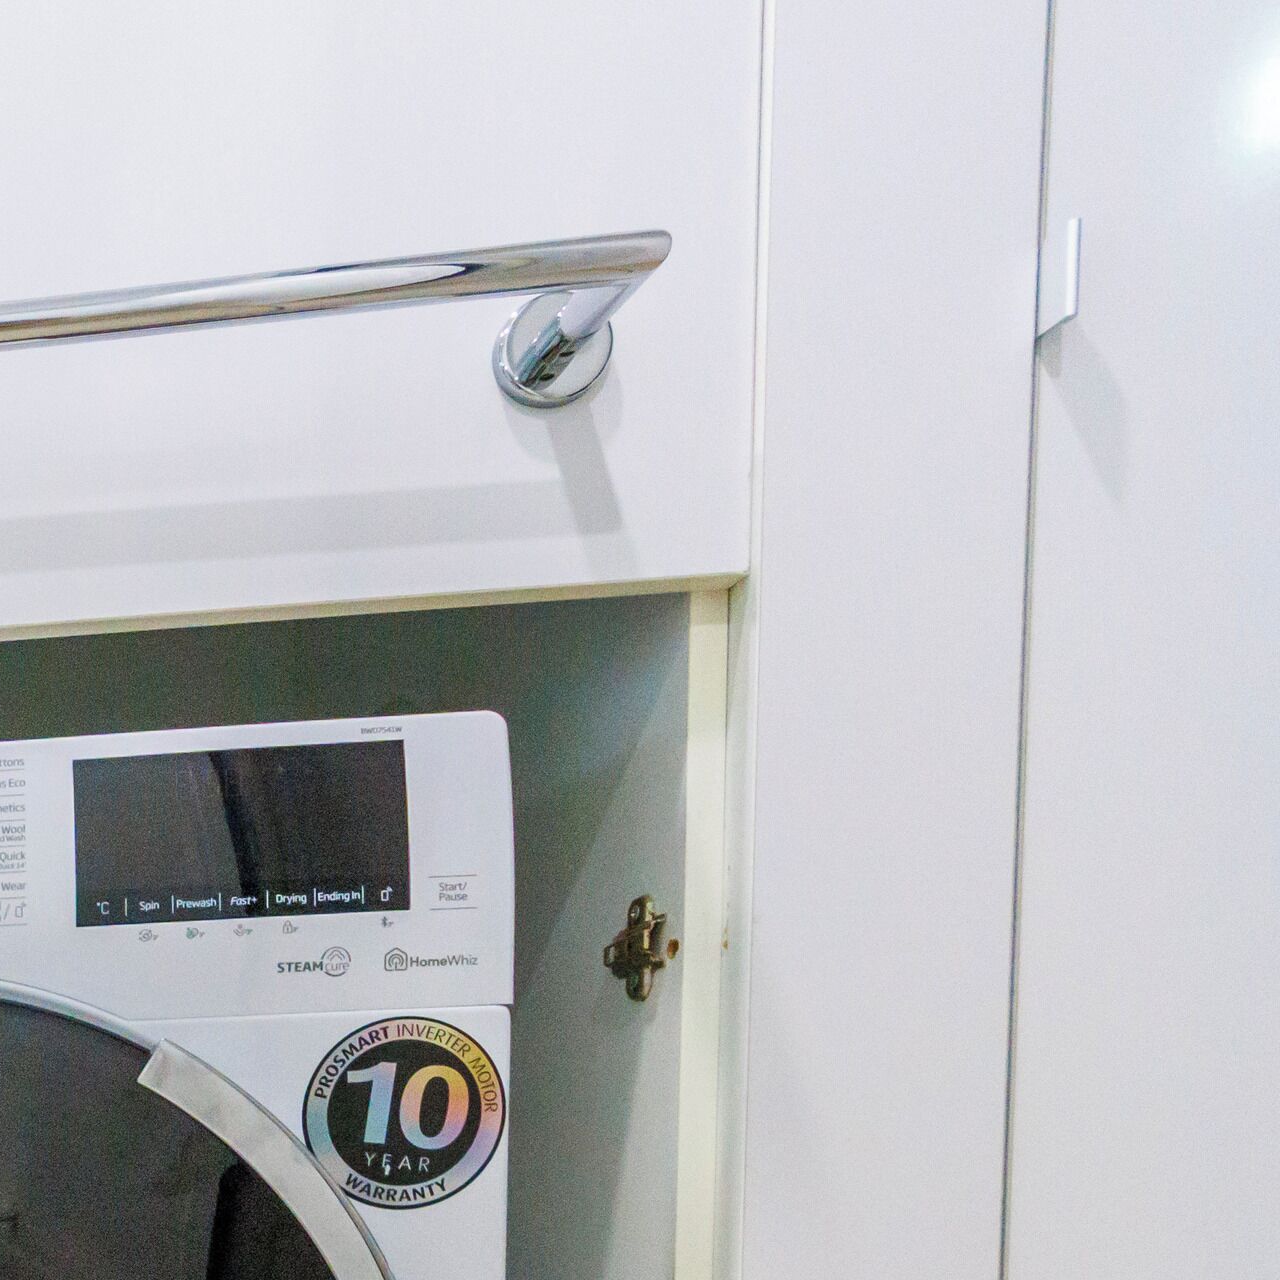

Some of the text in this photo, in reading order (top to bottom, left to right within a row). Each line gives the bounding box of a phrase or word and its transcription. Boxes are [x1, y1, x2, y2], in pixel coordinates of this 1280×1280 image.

[8, 778, 26, 788] Eco
[1, 824, 26, 834] Wool
[1, 881, 26, 891] Wear
[175, 896, 217, 910] Prewash
[275, 891, 307, 906] Drying
[317, 889, 350, 904] Ending
[439, 891, 468, 902] Pause
[139, 899, 160, 913] Spin
[409, 953, 479, 968] HomeWhiz
[314, 1022, 498, 1113] PROSMART INVERTER MOTOR
[346, 1061, 470, 1151] 10
[364, 1151, 431, 1173] YEAR
[345, 1172, 447, 1202] WARRANTY
